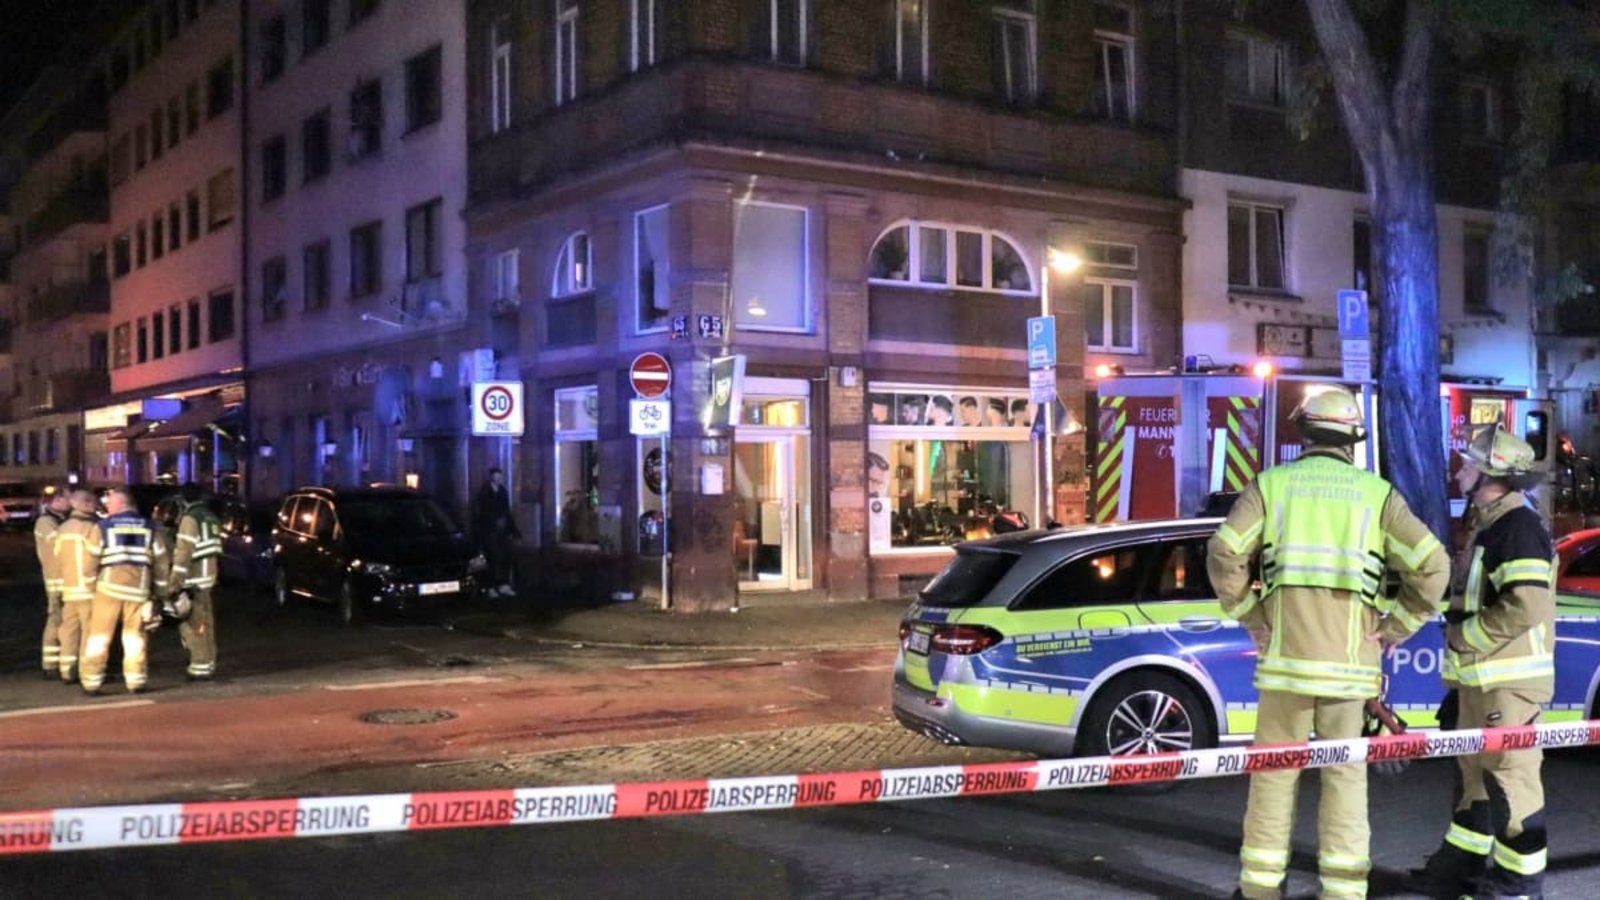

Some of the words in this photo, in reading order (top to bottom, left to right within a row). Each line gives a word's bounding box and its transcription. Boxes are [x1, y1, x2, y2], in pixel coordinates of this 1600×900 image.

[1345, 297, 1361, 330] P
[1032, 321, 1044, 342] P
[488, 395, 508, 411] 30
[485, 421, 512, 432] ZONE
[121, 805, 370, 839] POLIZEIABSPERRUNG
[401, 793, 617, 826] POLIZEIABSPERRUNG
[646, 781, 837, 813] POLIZEIABSPERRUNG
[860, 771, 1028, 799] POLIZEIABSPERRUNG
[1050, 757, 1198, 785] POLIZEIABSPERRUNG
[1216, 746, 1349, 772] POLIZEIABSPERRUNG
[1366, 735, 1486, 760] POLIZEIABSPERRUNG
